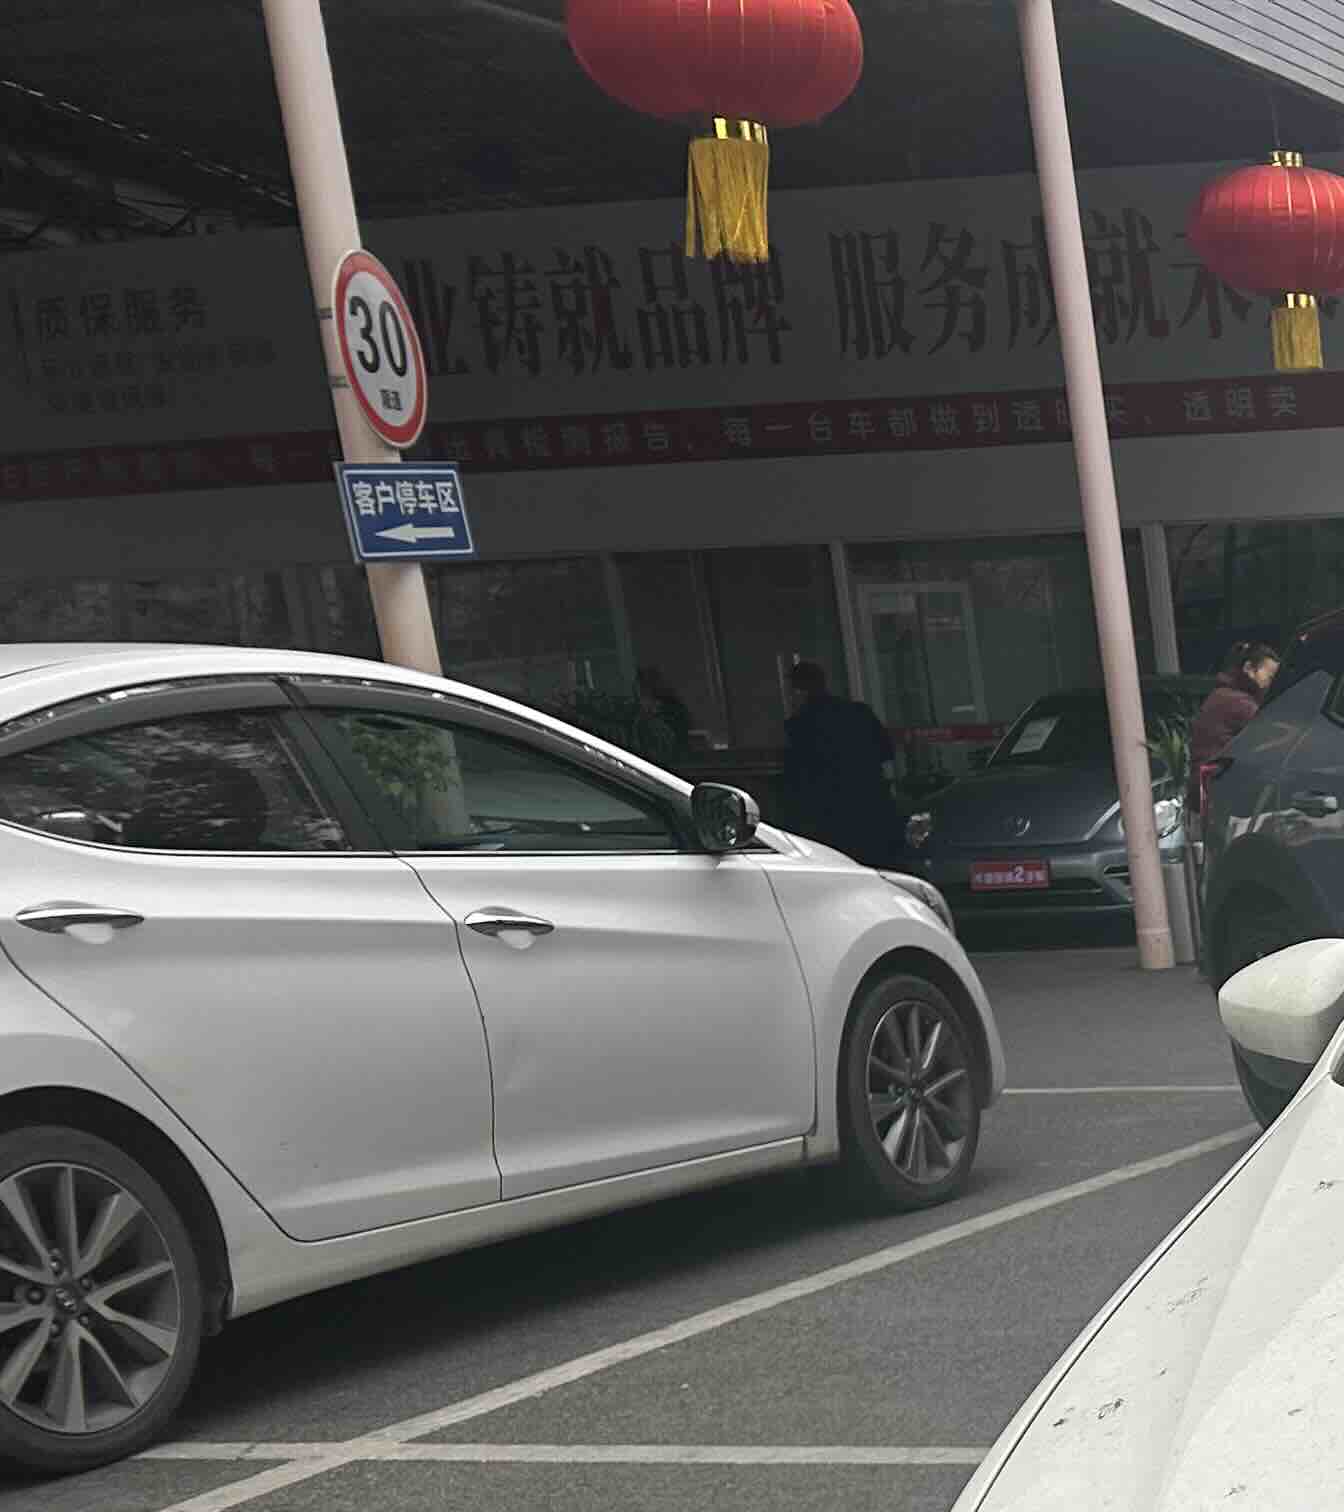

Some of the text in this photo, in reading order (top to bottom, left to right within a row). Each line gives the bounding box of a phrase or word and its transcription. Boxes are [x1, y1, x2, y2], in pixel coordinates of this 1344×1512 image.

[828, 207, 1338, 360] 服务成就未
[349, 295, 408, 378] 30
[352, 479, 459, 516] 客户停车区
